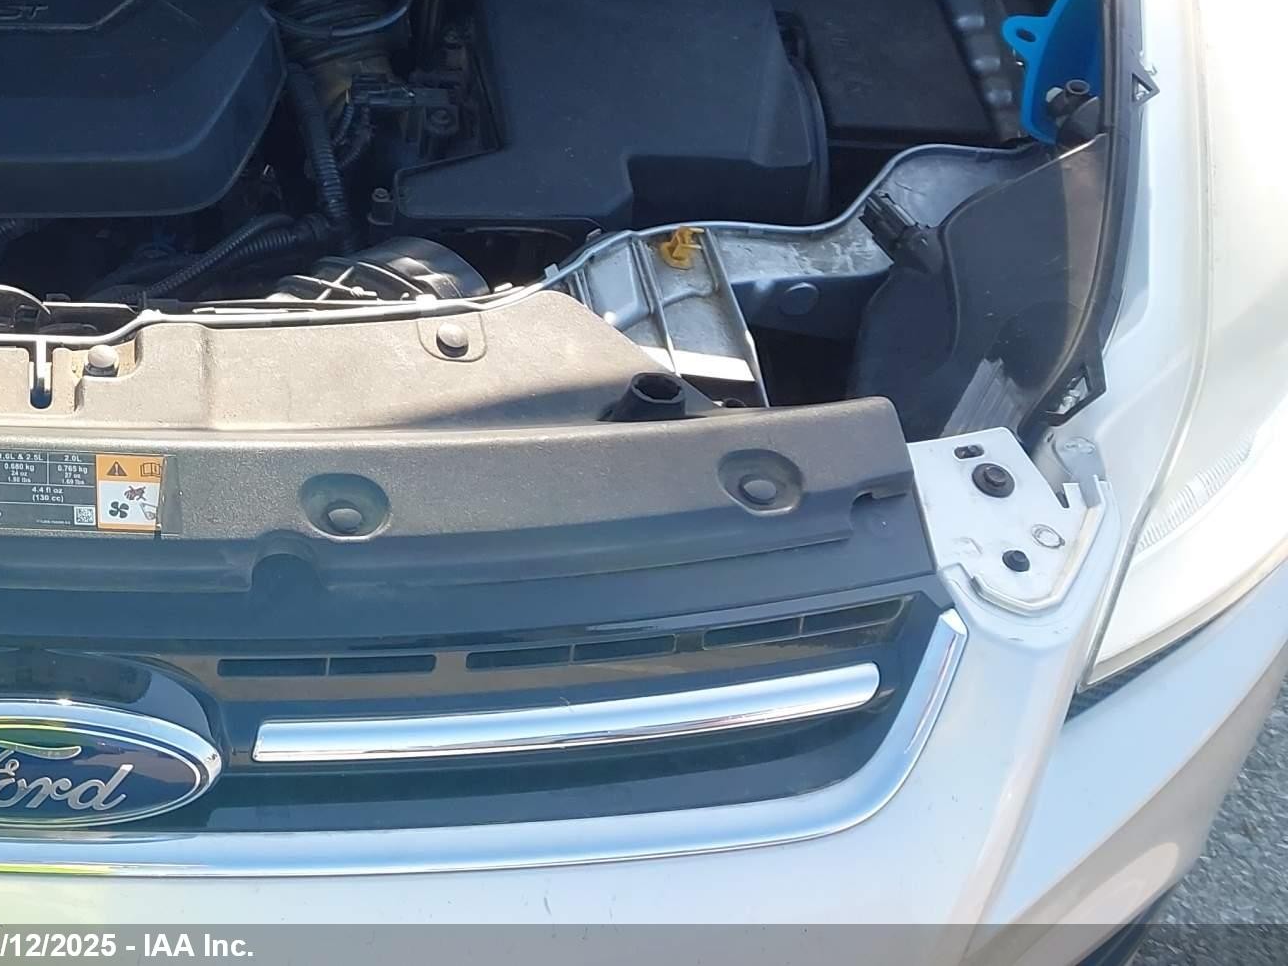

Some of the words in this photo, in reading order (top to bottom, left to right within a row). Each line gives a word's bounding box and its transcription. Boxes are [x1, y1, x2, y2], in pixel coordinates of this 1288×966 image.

[64, 454, 82, 462] 2.0L
[25, 462, 35, 472] kg
[78, 465, 88, 474] kg
[31, 486, 44, 494] 4.4
[32, 494, 49, 502] (130
[51, 495, 64, 503] cc)
